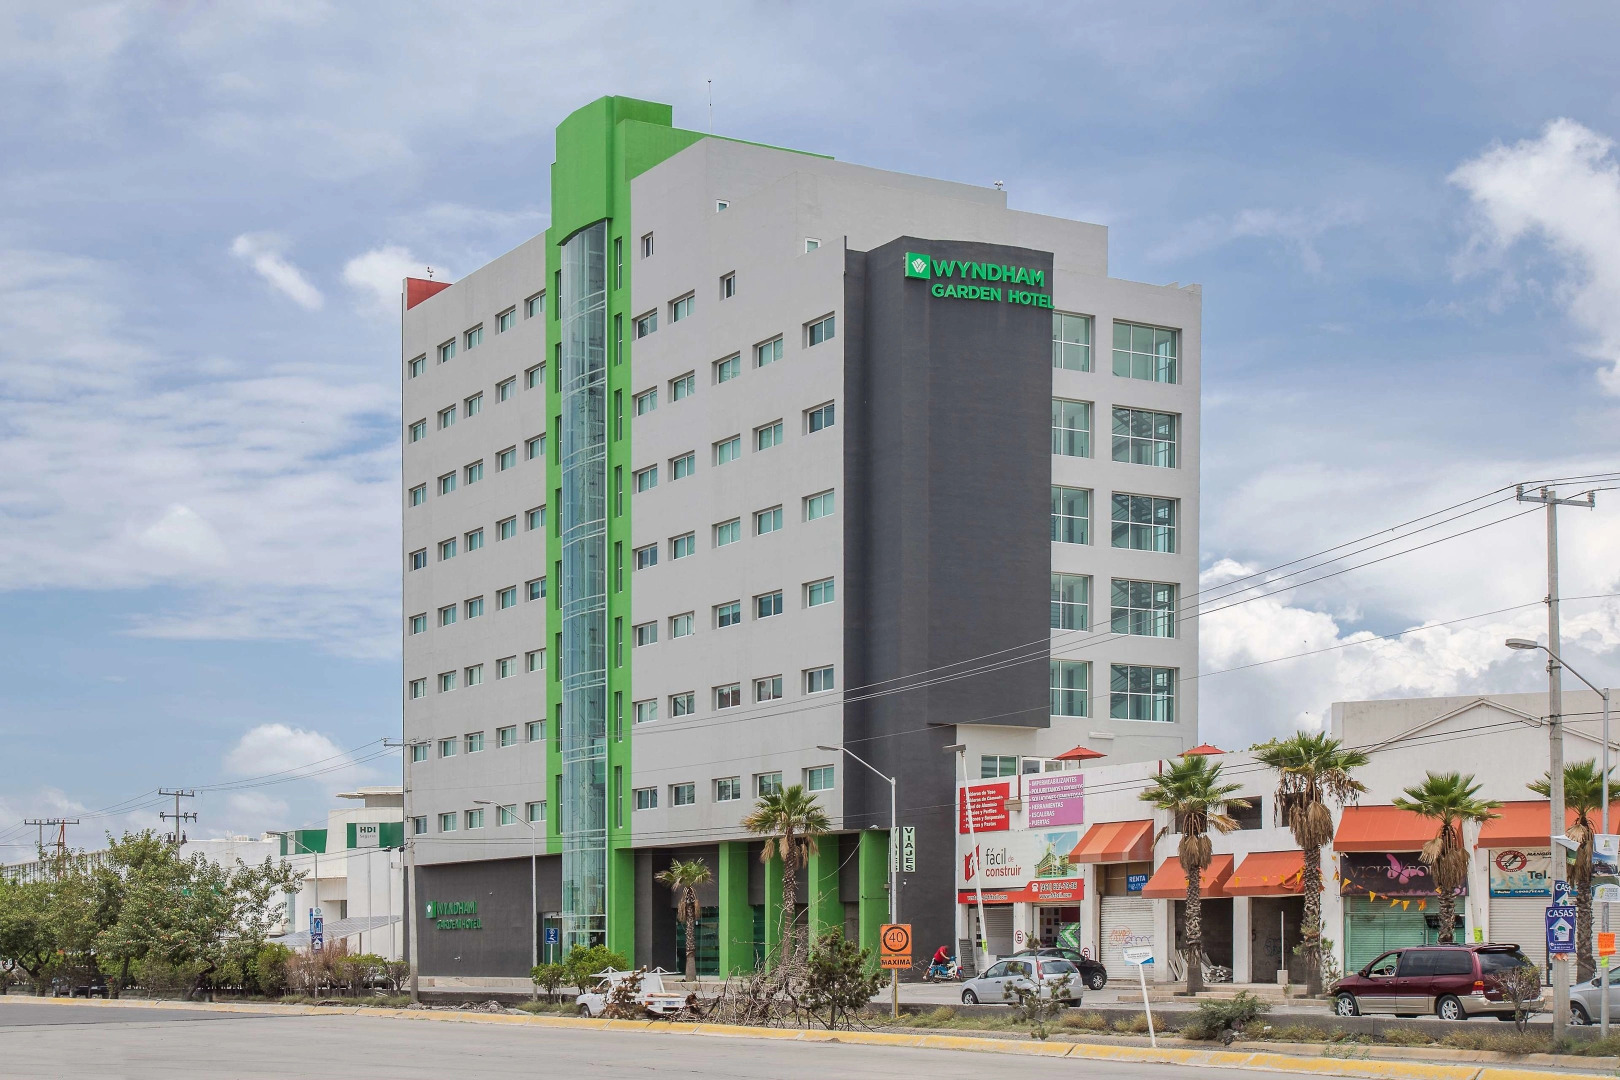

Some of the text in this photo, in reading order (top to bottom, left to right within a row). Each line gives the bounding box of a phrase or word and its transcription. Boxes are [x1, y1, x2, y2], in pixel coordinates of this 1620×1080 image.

[932, 260, 1045, 287] WYNDHAM
[931, 284, 1055, 309] GARDEN HOTEL
[1031, 776, 1077, 786] IMPERMEABILIZANTES
[1031, 801, 1064, 810] HERRAMIENTAS
[1031, 810, 1055, 818] ESCALERAS
[1031, 818, 1050, 826] PUERTAS
[904, 827, 914, 871] VIAJES
[985, 847, 1014, 866] fácil de
[985, 864, 1021, 877] construir
[1527, 869, 1551, 880] Tel.
[1129, 875, 1146, 883] RENTA
[437, 901, 477, 915] WYNDHAM
[1547, 909, 1574, 918] CASAS
[437, 917, 482, 930] GARDEN HOTEL
[889, 931, 904, 943] 40
